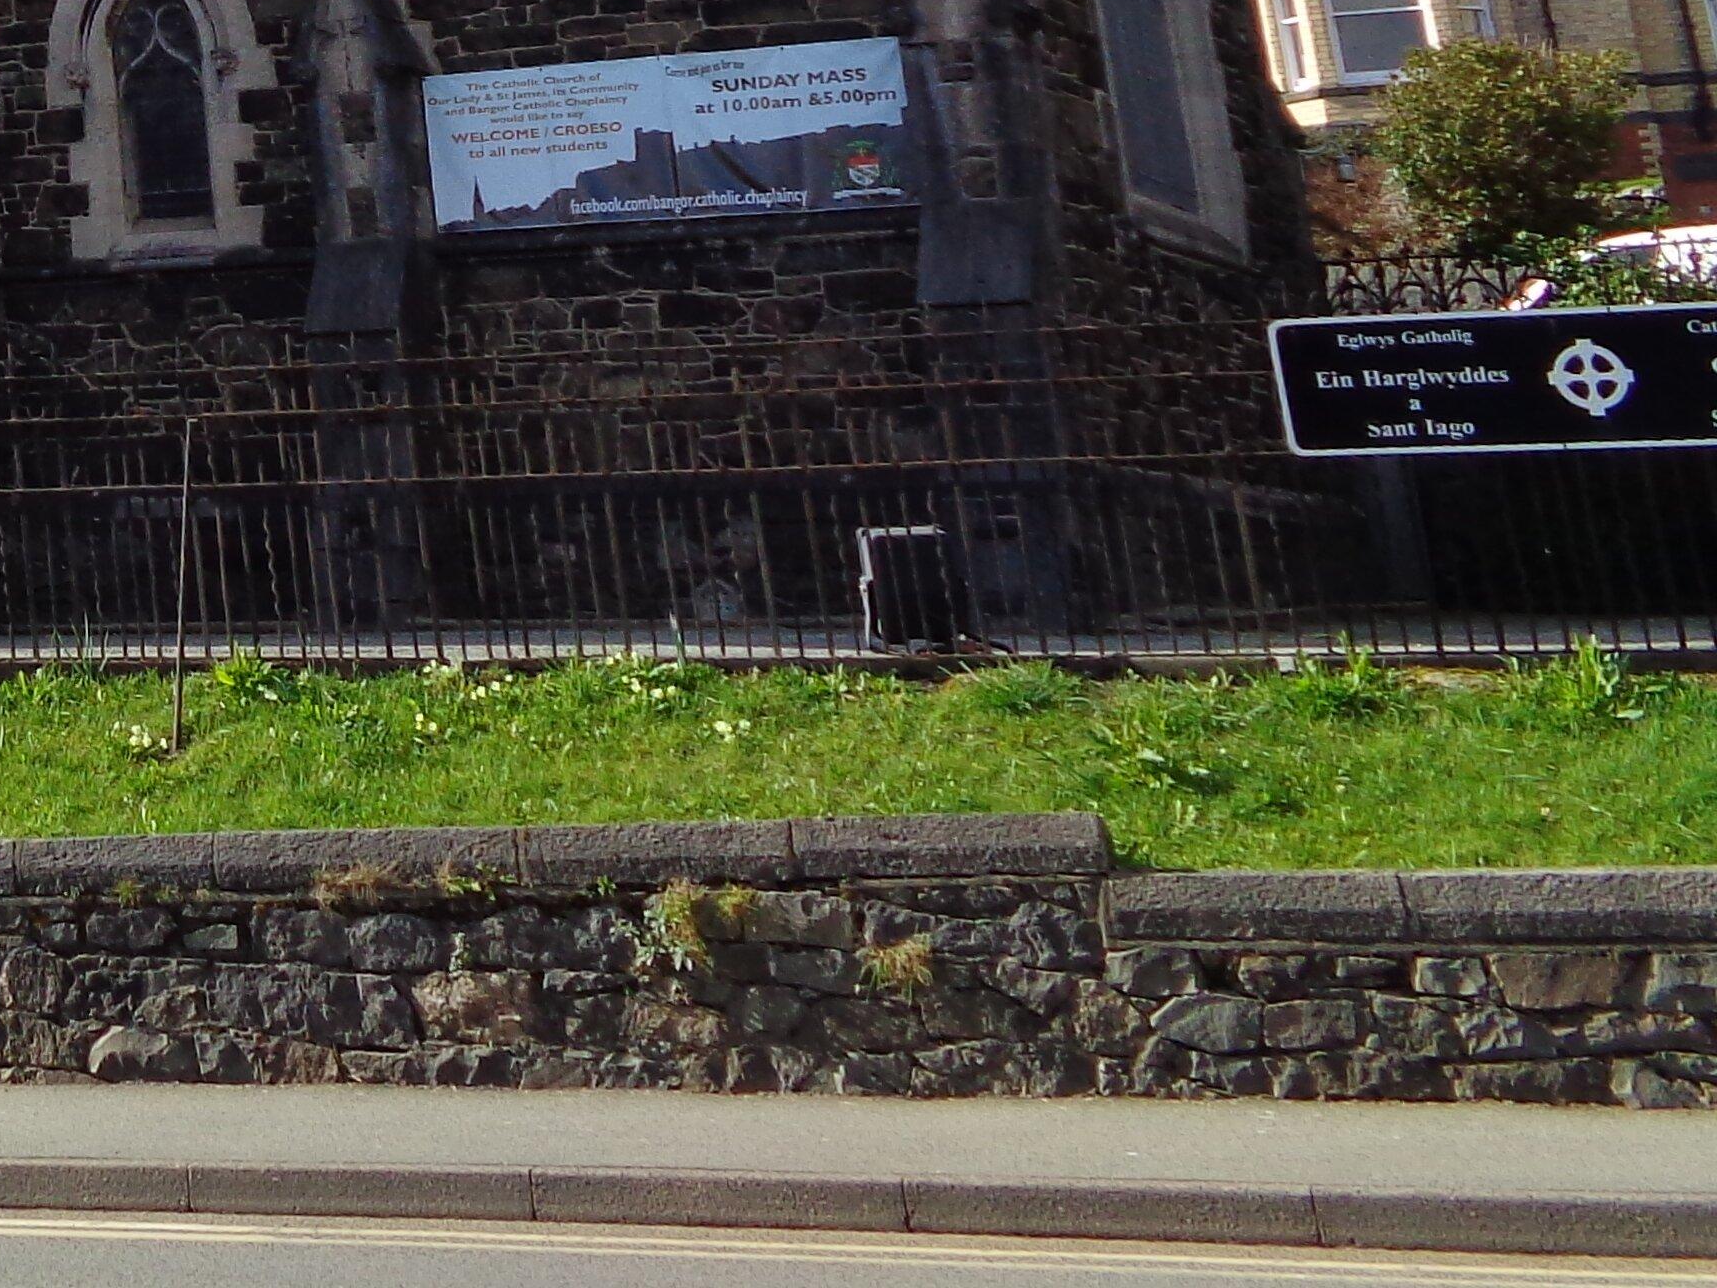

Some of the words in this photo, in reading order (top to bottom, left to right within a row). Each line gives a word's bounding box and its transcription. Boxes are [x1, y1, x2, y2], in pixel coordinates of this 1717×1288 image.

[466, 83, 489, 91] The
[492, 78, 539, 90] Catholic
[544, 74, 585, 85] Church
[589, 73, 601, 82] of
[711, 73, 800, 93] SUNDAY
[807, 67, 868, 86] MASS
[428, 97, 451, 106] Our
[454, 96, 481, 106] Lady
[569, 83, 639, 96] Community
[445, 107, 465, 116] and
[469, 104, 510, 116] Bangor
[513, 101, 562, 111] Catholic
[566, 95, 628, 108] Chaplaincy
[695, 102, 715, 114] at
[722, 96, 802, 113] 10.00am
[808, 88, 898, 106] &5.00pm
[490, 112, 525, 124] would
[528, 111, 548, 122] like
[551, 111, 564, 120] to
[567, 110, 584, 121] say
[451, 127, 541, 143] WELCOME
[553, 121, 623, 137] CROESO
[469, 148, 484, 159] to
[489, 146, 506, 158] all
[510, 145, 541, 156] new
[545, 140, 609, 154] students
[570, 188, 807, 214] facebook.com/bangor.catholic.chaplaincy
[1336, 333, 1395, 350] Eglwys
[1401, 328, 1475, 345] Gatholig
[1316, 370, 1354, 389] Ein
[1362, 366, 1510, 390] Harglwyddes
[1408, 397, 1422, 412] a
[1367, 420, 1417, 438] Sant
[1425, 418, 1476, 440] Iago
